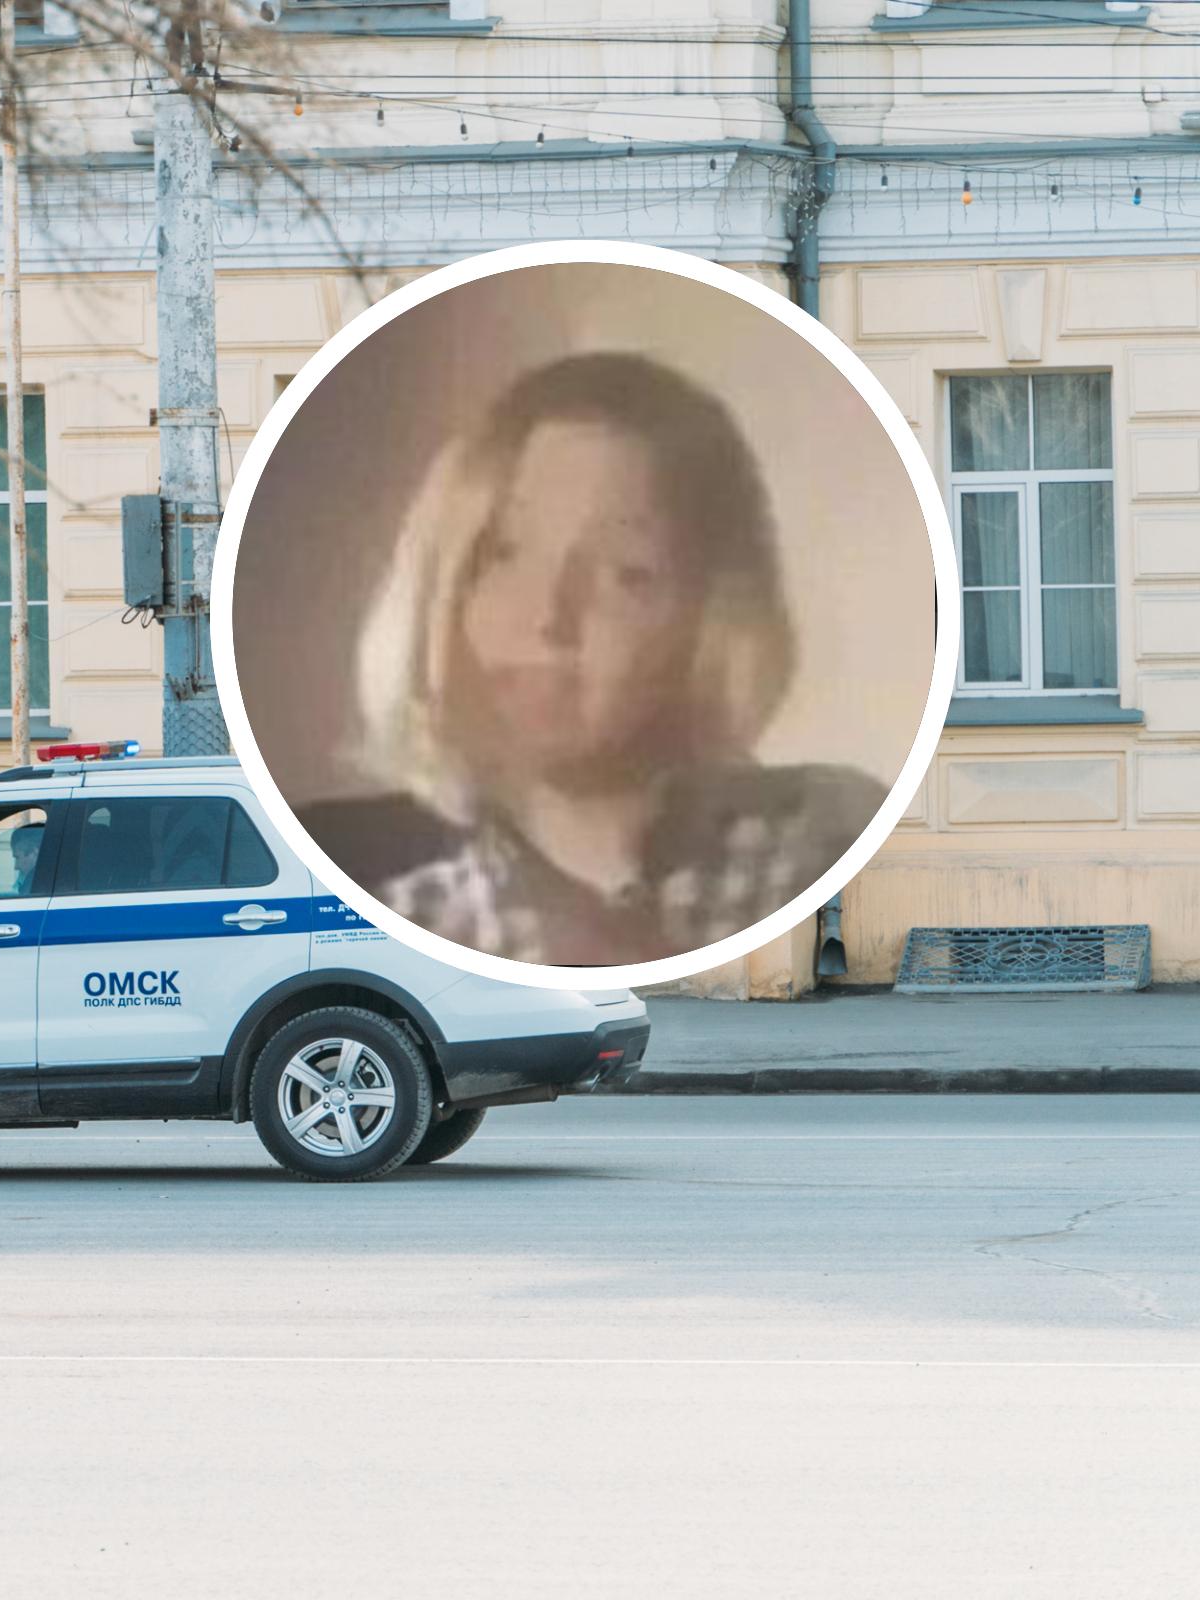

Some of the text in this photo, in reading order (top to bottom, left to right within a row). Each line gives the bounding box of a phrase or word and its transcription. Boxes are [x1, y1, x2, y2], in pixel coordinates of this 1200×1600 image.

[84, 970, 180, 996] ОМСК
[84, 996, 182, 1008] ПОЛК ДПС ГИБДД
